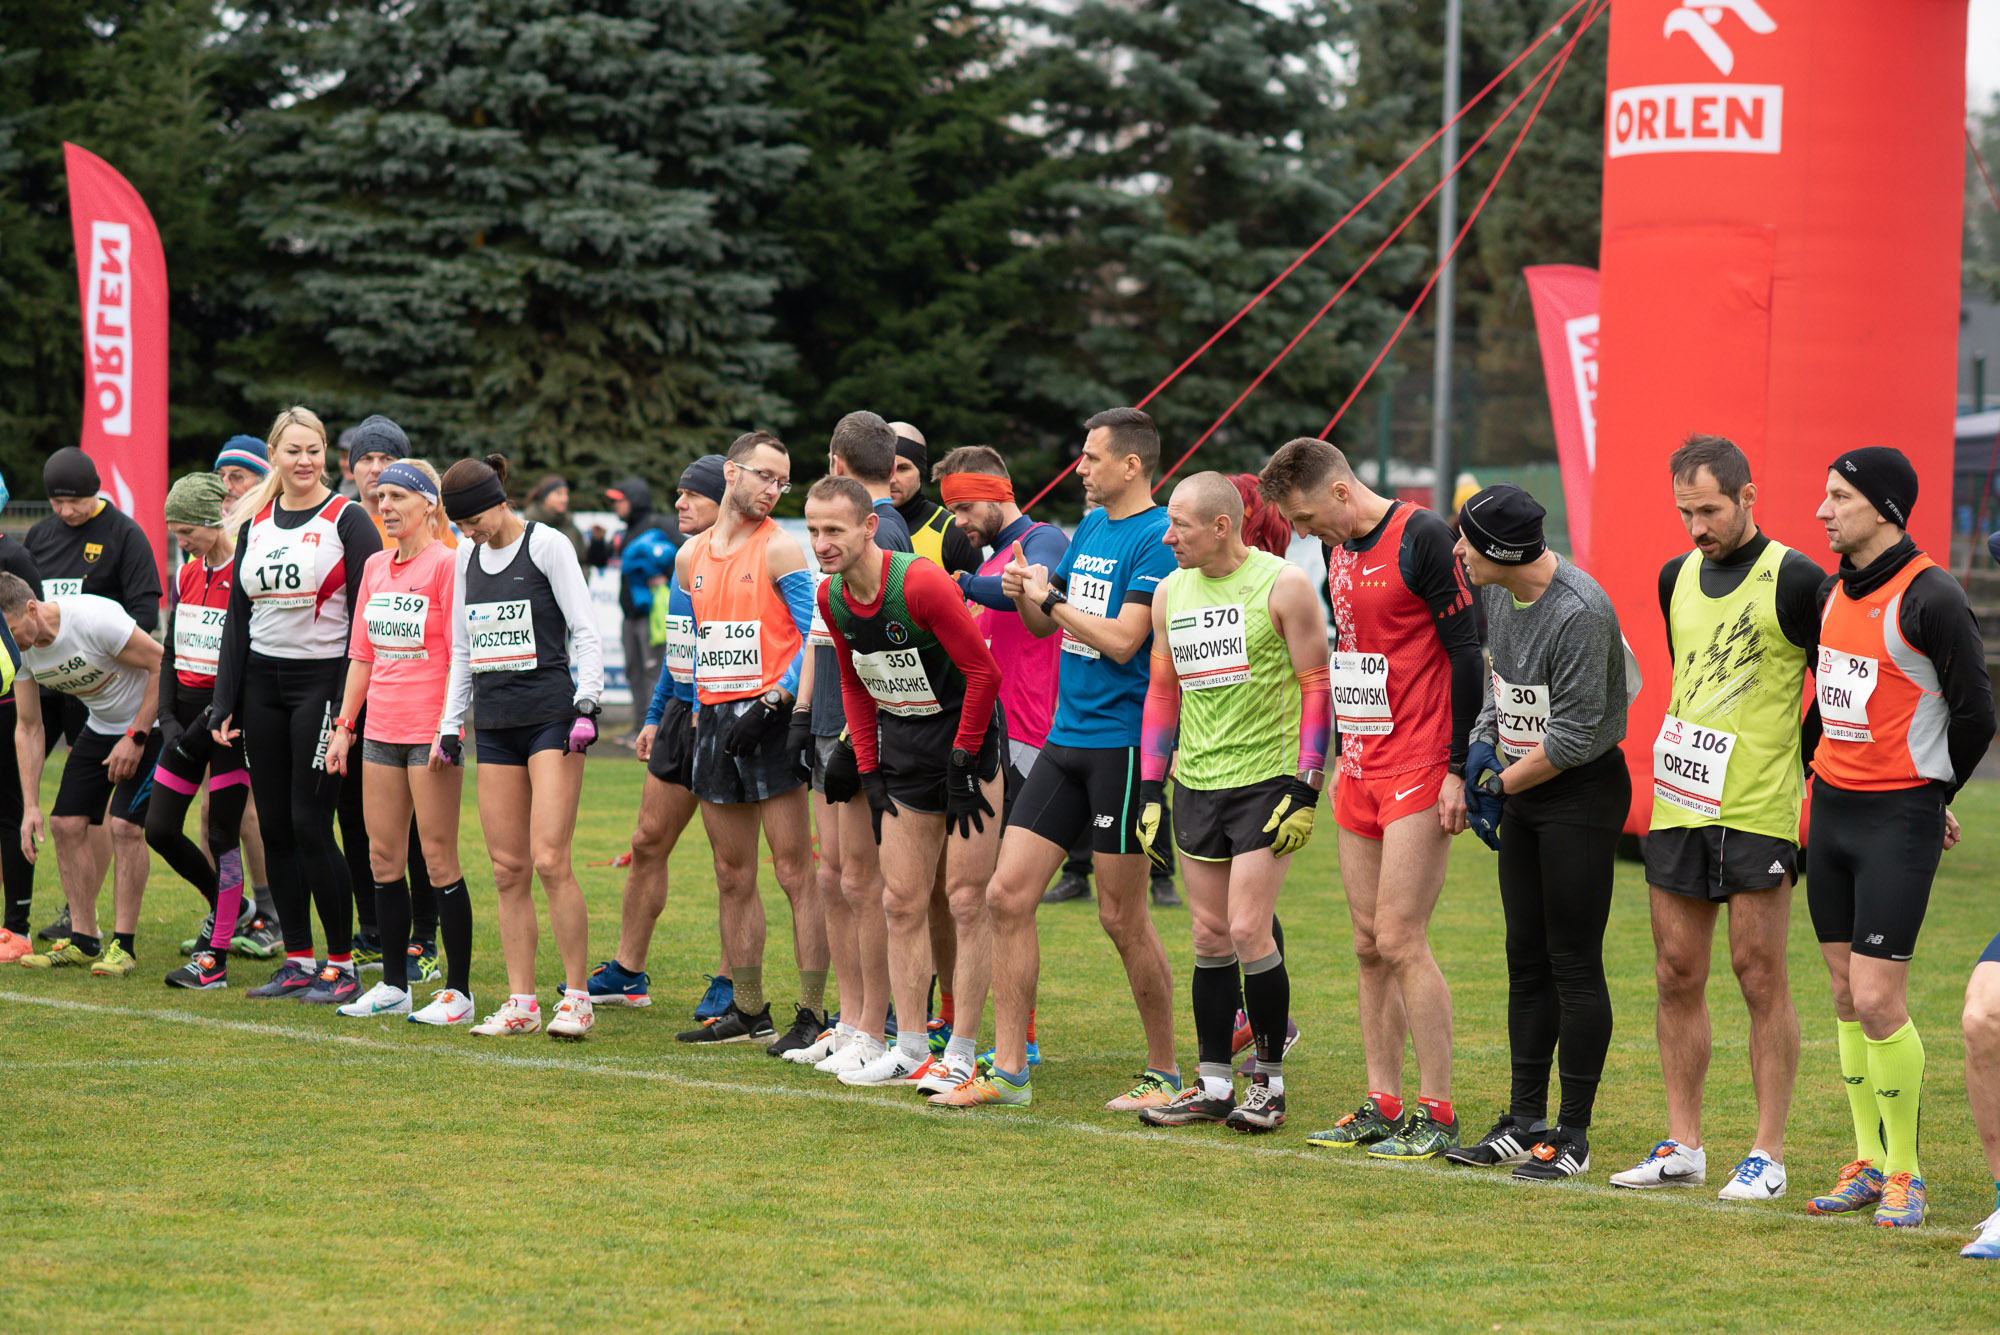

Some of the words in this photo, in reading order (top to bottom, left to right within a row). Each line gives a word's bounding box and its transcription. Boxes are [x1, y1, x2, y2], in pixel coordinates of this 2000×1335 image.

[1615, 96, 1765, 144] ORLEN
[1884, 498, 1904, 524] TERVEL
[1072, 553, 1118, 576] BROOKS
[255, 563, 301, 592] 178
[52, 582, 78, 596] 192
[1081, 580, 1106, 602] 111
[393, 596, 424, 613] 569
[497, 603, 526, 621] 237
[201, 610, 227, 627] 276
[1203, 607, 1240, 629] 570
[368, 620, 421, 638] AWŁOWSKA
[724, 623, 756, 639] 166
[471, 629, 532, 649] WOSZCZEK
[412, 652, 425, 660] 2021
[666, 643, 696, 660] ARTKOW
[696, 649, 759, 670] ŁABĘDZKI
[1173, 636, 1243, 664] PAWŁOWSKI
[58, 656, 87, 675] 568
[521, 660, 535, 668] 2021
[885, 652, 917, 668] 350
[1360, 656, 1386, 675] 404
[1847, 657, 1869, 679] 96
[745, 681, 759, 689] 2021
[862, 676, 929, 695] PIOTRASCHKE
[1183, 679, 1206, 689] TOMASZÓW
[1206, 675, 1232, 685] LUBELSKI
[1232, 673, 1249, 682] 2021
[1334, 686, 1388, 706] GUZOWSKI
[1511, 687, 1537, 705] 30
[1821, 684, 1852, 709] KERN
[925, 705, 939, 714] 2021
[1360, 724, 1381, 732] LUBELSKI
[1497, 706, 1548, 734] BCZYK
[1691, 729, 1729, 754] 106
[1831, 728, 1854, 738] LUBELSKI
[1854, 731, 1868, 739] 2021
[1510, 746, 1531, 755] LUBEL
[1664, 752, 1710, 785] ORZEŁ
[1656, 787, 1681, 804] TOMASZÓW
[1681, 798, 1704, 812] LUBELSKI
[1704, 805, 1718, 816] 2021
